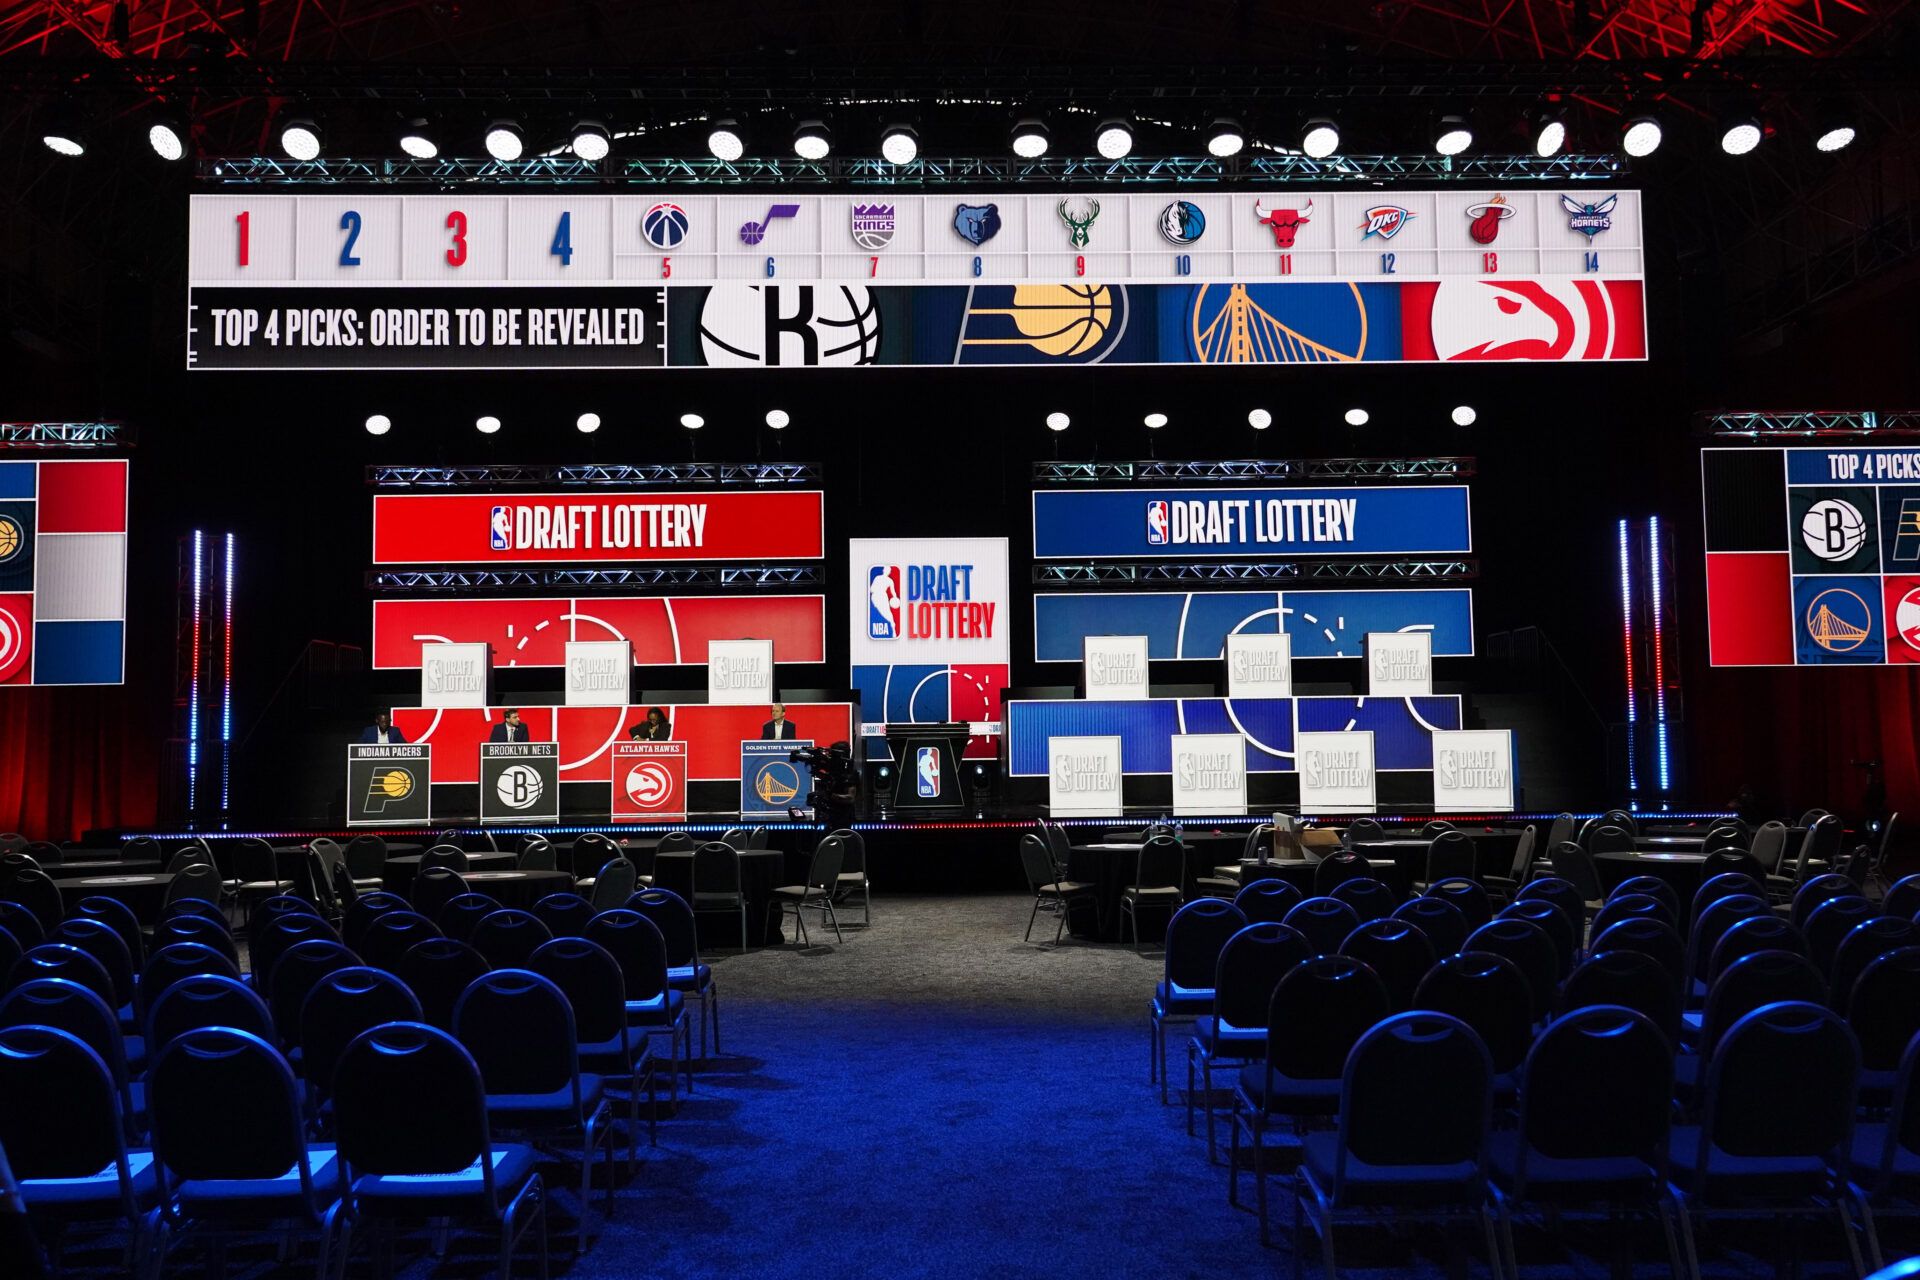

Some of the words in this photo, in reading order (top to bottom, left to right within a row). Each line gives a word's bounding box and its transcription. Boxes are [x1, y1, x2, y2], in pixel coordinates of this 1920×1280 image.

[854, 221, 894, 230] KINGS
[1571, 217, 1609, 228] HORNETS
[236, 210, 250, 266] 1
[339, 210, 362, 266] 2
[446, 210, 468, 267] 3
[551, 210, 573, 266] 4
[662, 256, 672, 279] 5
[766, 257, 776, 278] 6
[870, 256, 879, 278] 7
[973, 256, 983, 277] 8
[1076, 255, 1086, 277] 9
[1175, 254, 1192, 276] 10
[1279, 253, 1292, 275] 11
[1381, 253, 1396, 274] 12
[1483, 252, 1499, 274] 13
[1584, 252, 1600, 273] 14
[211, 308, 259, 346] TOP
[264, 308, 279, 346] 4
[286, 308, 363, 346] PICKS:
[370, 308, 450, 346] ORDER
[455, 308, 483, 346] TO
[492, 308, 521, 346] BE
[528, 308, 645, 346] REVEALED
[1828, 453, 1859, 480] TOP
[1863, 453, 1874, 479] 4
[1876, 453, 1920, 479] PICKS
[515, 505, 597, 549] DRAFT
[602, 503, 708, 549] LOTTERY
[1172, 500, 1250, 543] DRAFT
[1255, 498, 1357, 543] LOTTERY
[908, 565, 973, 602] DRAFT
[872, 622, 889, 635] NBA
[908, 602, 996, 639] LOTTERY
[587, 658, 616, 674] DRAFT
[731, 656, 760, 672] DRAFT
[1107, 652, 1136, 668] DRAFT
[1250, 650, 1279, 666] DRAFT
[1390, 648, 1419, 665] DRAFT
[444, 658, 474, 675] DRAFT
[1107, 668, 1145, 684] LOTTERY
[1250, 665, 1287, 682] LOTTERY
[1390, 664, 1428, 680] LOTTERY
[444, 675, 482, 692] LOTTERY
[587, 673, 626, 690] LOTTERY
[731, 672, 769, 688] LOTTERY
[358, 746, 390, 757] INDIANA
[392, 746, 422, 757] PACERS
[489, 745, 528, 756] BROOKLYN
[532, 745, 551, 755] NETS
[619, 745, 653, 753] ATLANTA
[654, 744, 680, 753] HAWKS
[1075, 755, 1107, 773] DRAFT
[1199, 753, 1232, 771] DRAFT
[1326, 751, 1360, 769] DRAFT
[1459, 750, 1496, 769] DRAFT
[1075, 773, 1117, 792] LOTTERY
[1200, 771, 1242, 790] LOTTERY
[1325, 769, 1370, 788] LOTTERY
[1460, 768, 1507, 788] LOTTERY
[920, 785, 932, 795] NBA
